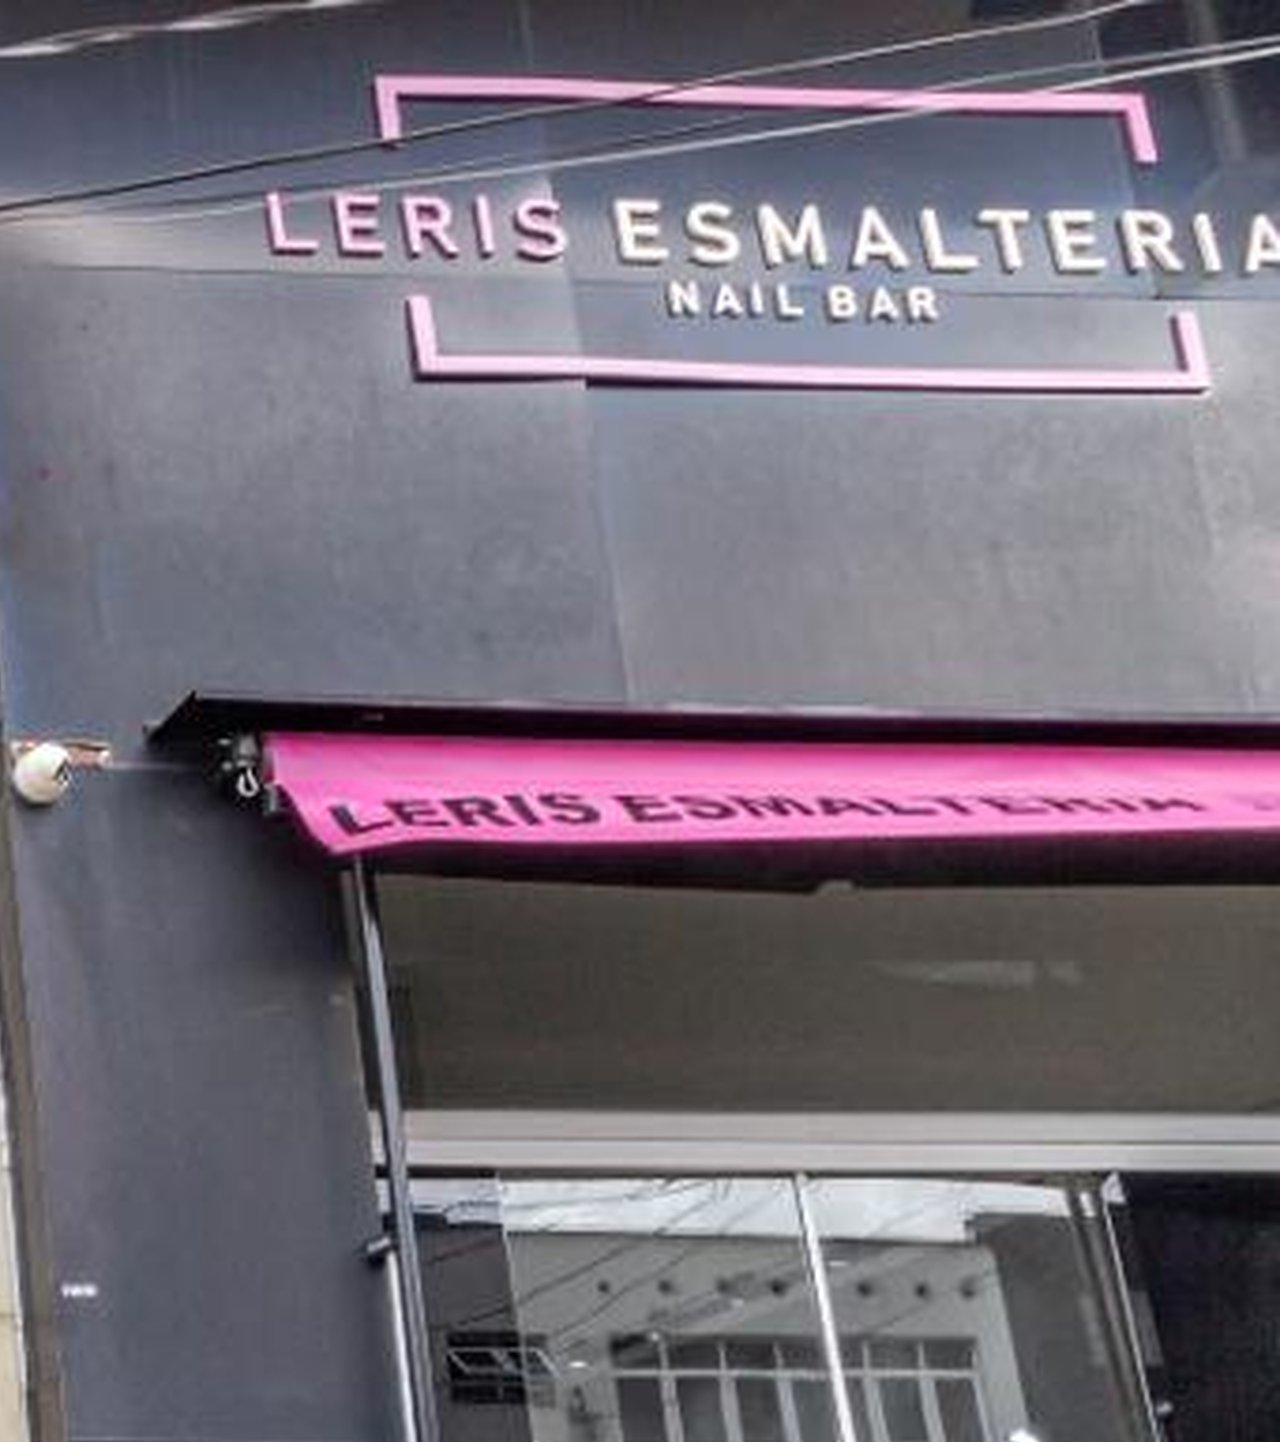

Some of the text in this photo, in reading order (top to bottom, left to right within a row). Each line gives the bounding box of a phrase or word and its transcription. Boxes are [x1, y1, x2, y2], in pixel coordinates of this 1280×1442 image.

[266, 192, 1280, 274] LERIS ESMALTERIA
[666, 280, 938, 323] NAIL BAR
[329, 794, 600, 836] LERIS
[612, 794, 1208, 824] ESMALTERIA
